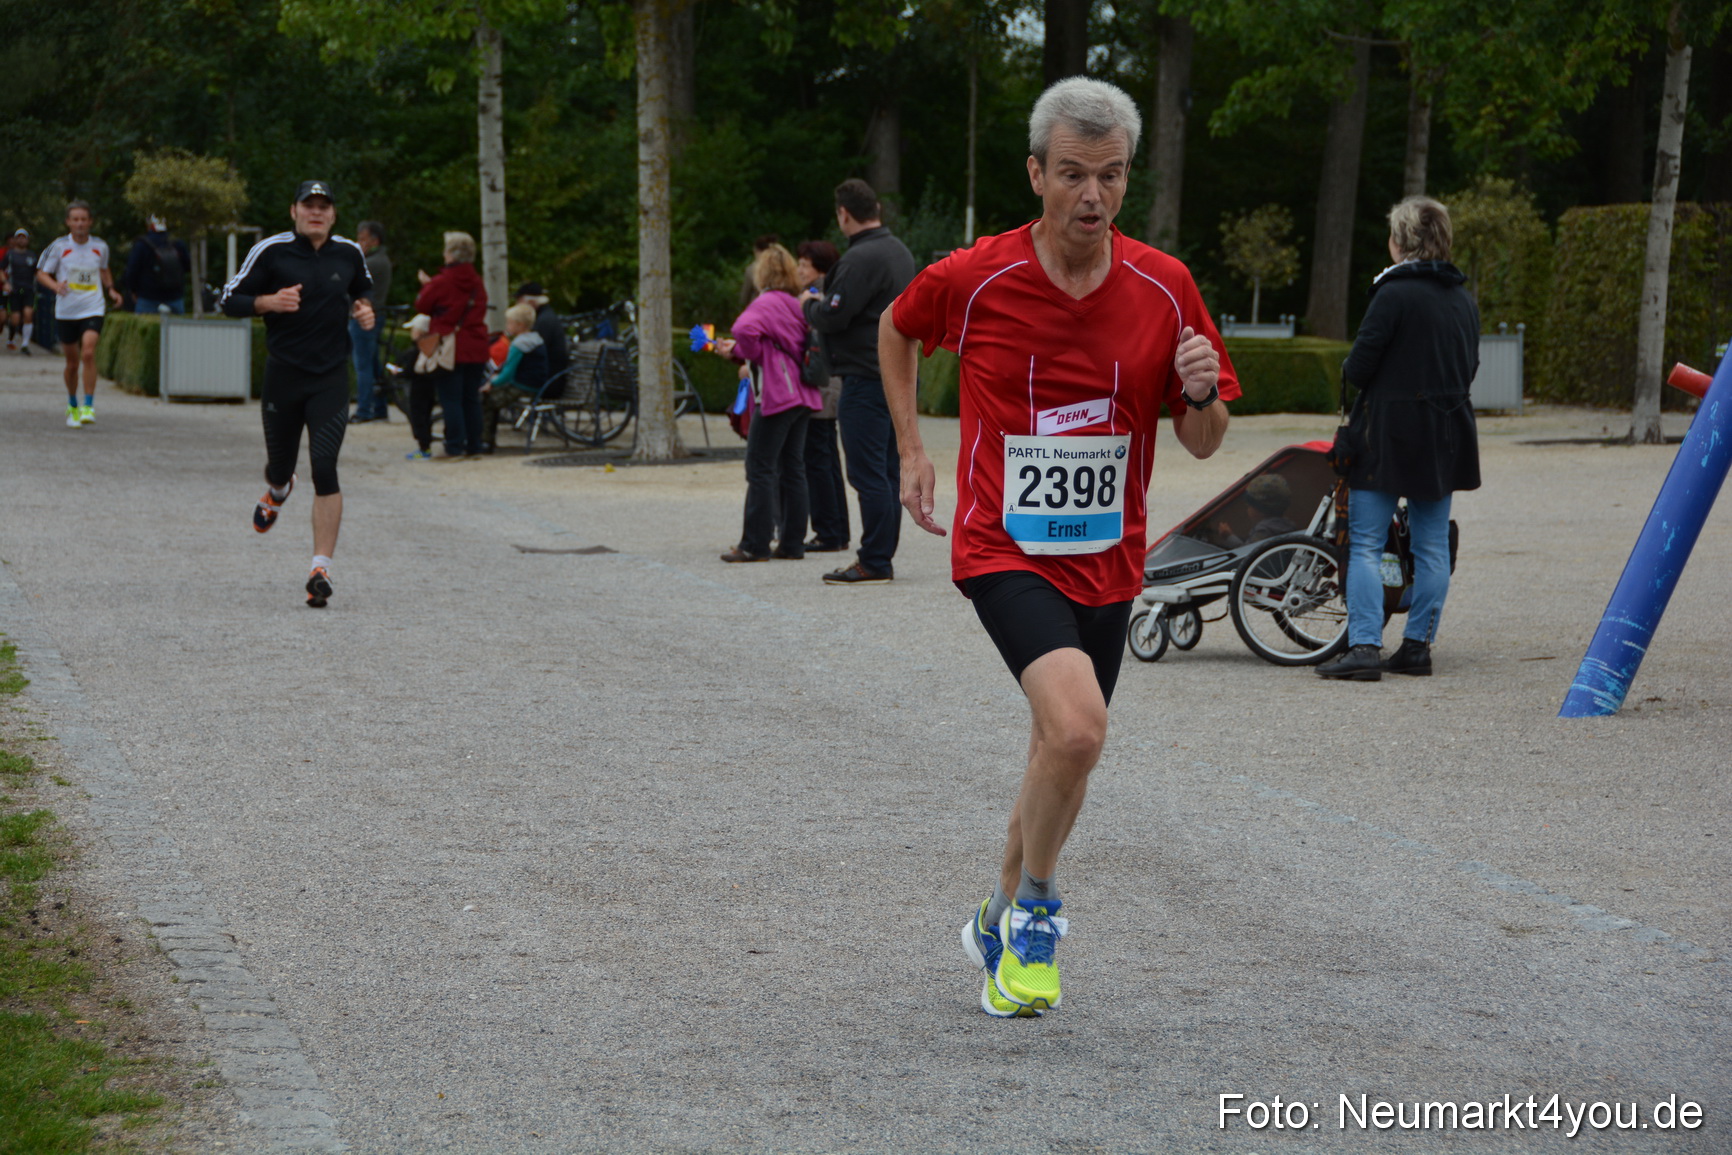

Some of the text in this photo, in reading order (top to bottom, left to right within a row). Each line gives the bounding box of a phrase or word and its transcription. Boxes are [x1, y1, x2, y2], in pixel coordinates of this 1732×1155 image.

[1056, 408, 1090, 425] DEHN
[1008, 447, 1050, 459] PARTL
[1053, 448, 1111, 460] Neumarkt
[1017, 465, 1116, 509] 2398
[1047, 521, 1088, 538] Ernst
